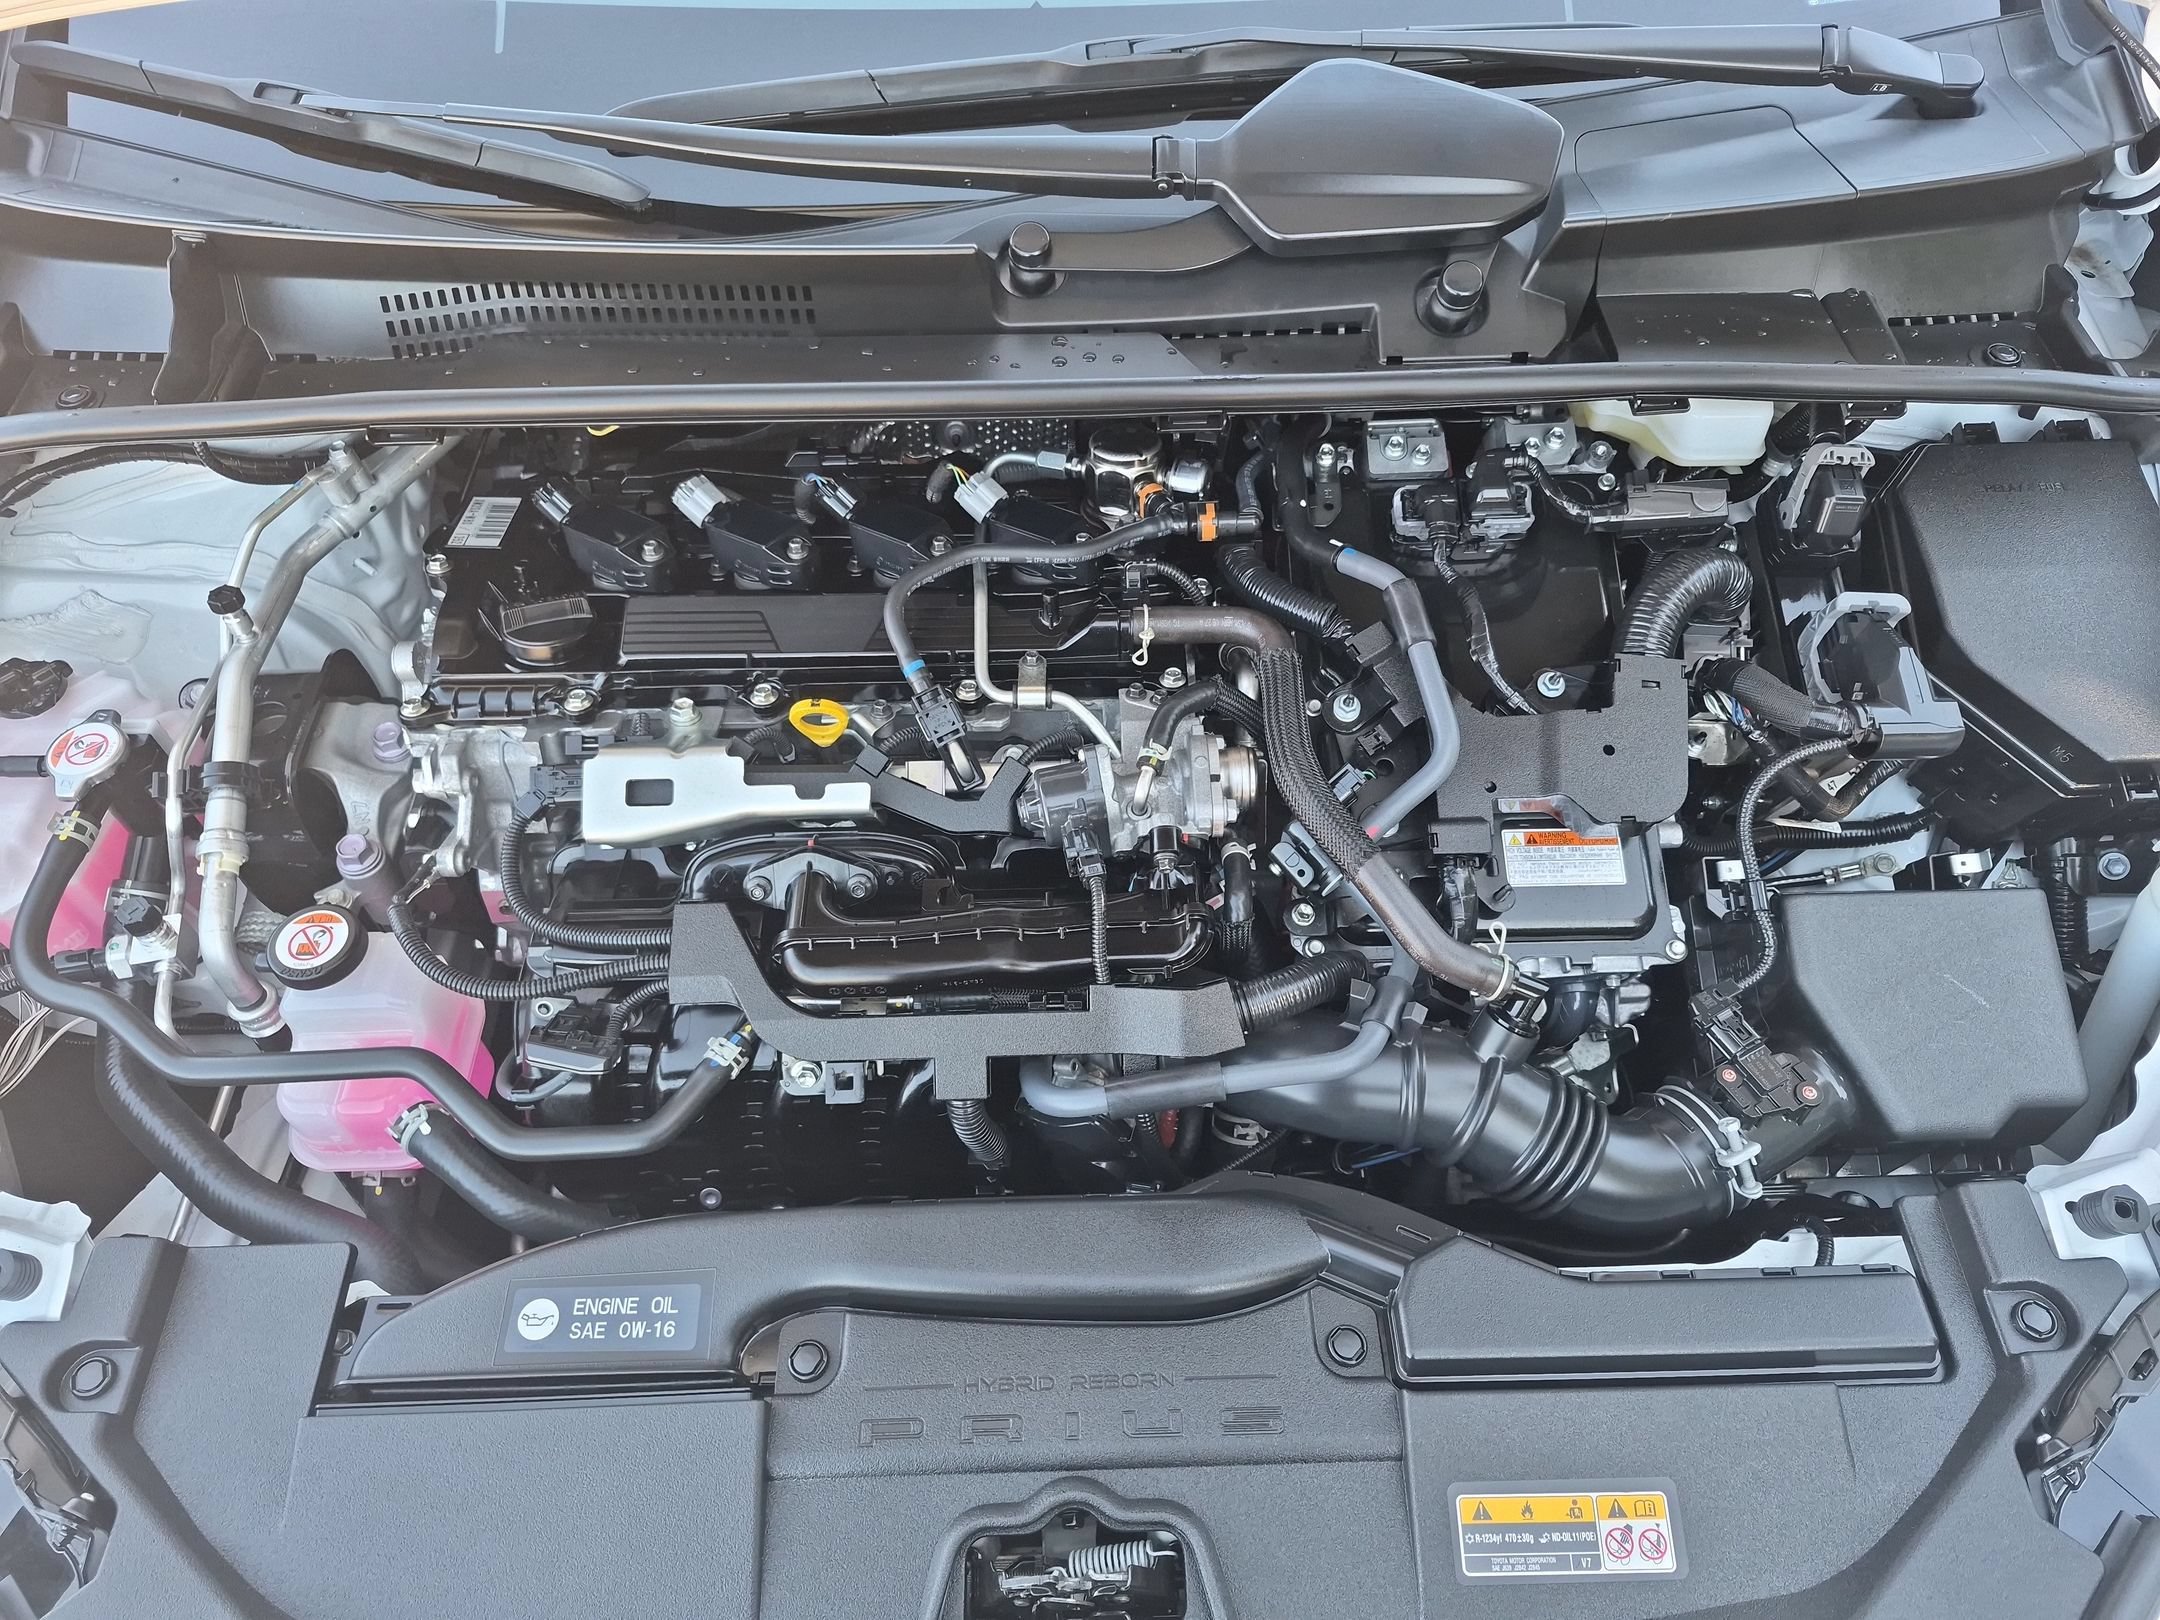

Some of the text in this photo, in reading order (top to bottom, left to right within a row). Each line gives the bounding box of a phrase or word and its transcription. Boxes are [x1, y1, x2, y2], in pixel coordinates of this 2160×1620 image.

[1827, 780, 1838, 791] 47
[1538, 832, 1567, 840] WARNING
[572, 1296, 679, 1316] ENGINE OIL
[569, 1320, 676, 1340] SAE 0W-16
[963, 1371, 1176, 1393] HYBRID REBORN
[857, 1405, 1286, 1448] PRIUS
[1474, 1531, 1597, 1545] R-1234yf 470±30g ND-OIL11(POE)
[1491, 1557, 1508, 1565] TOYOTA
[1581, 1557, 1592, 1569] V7
